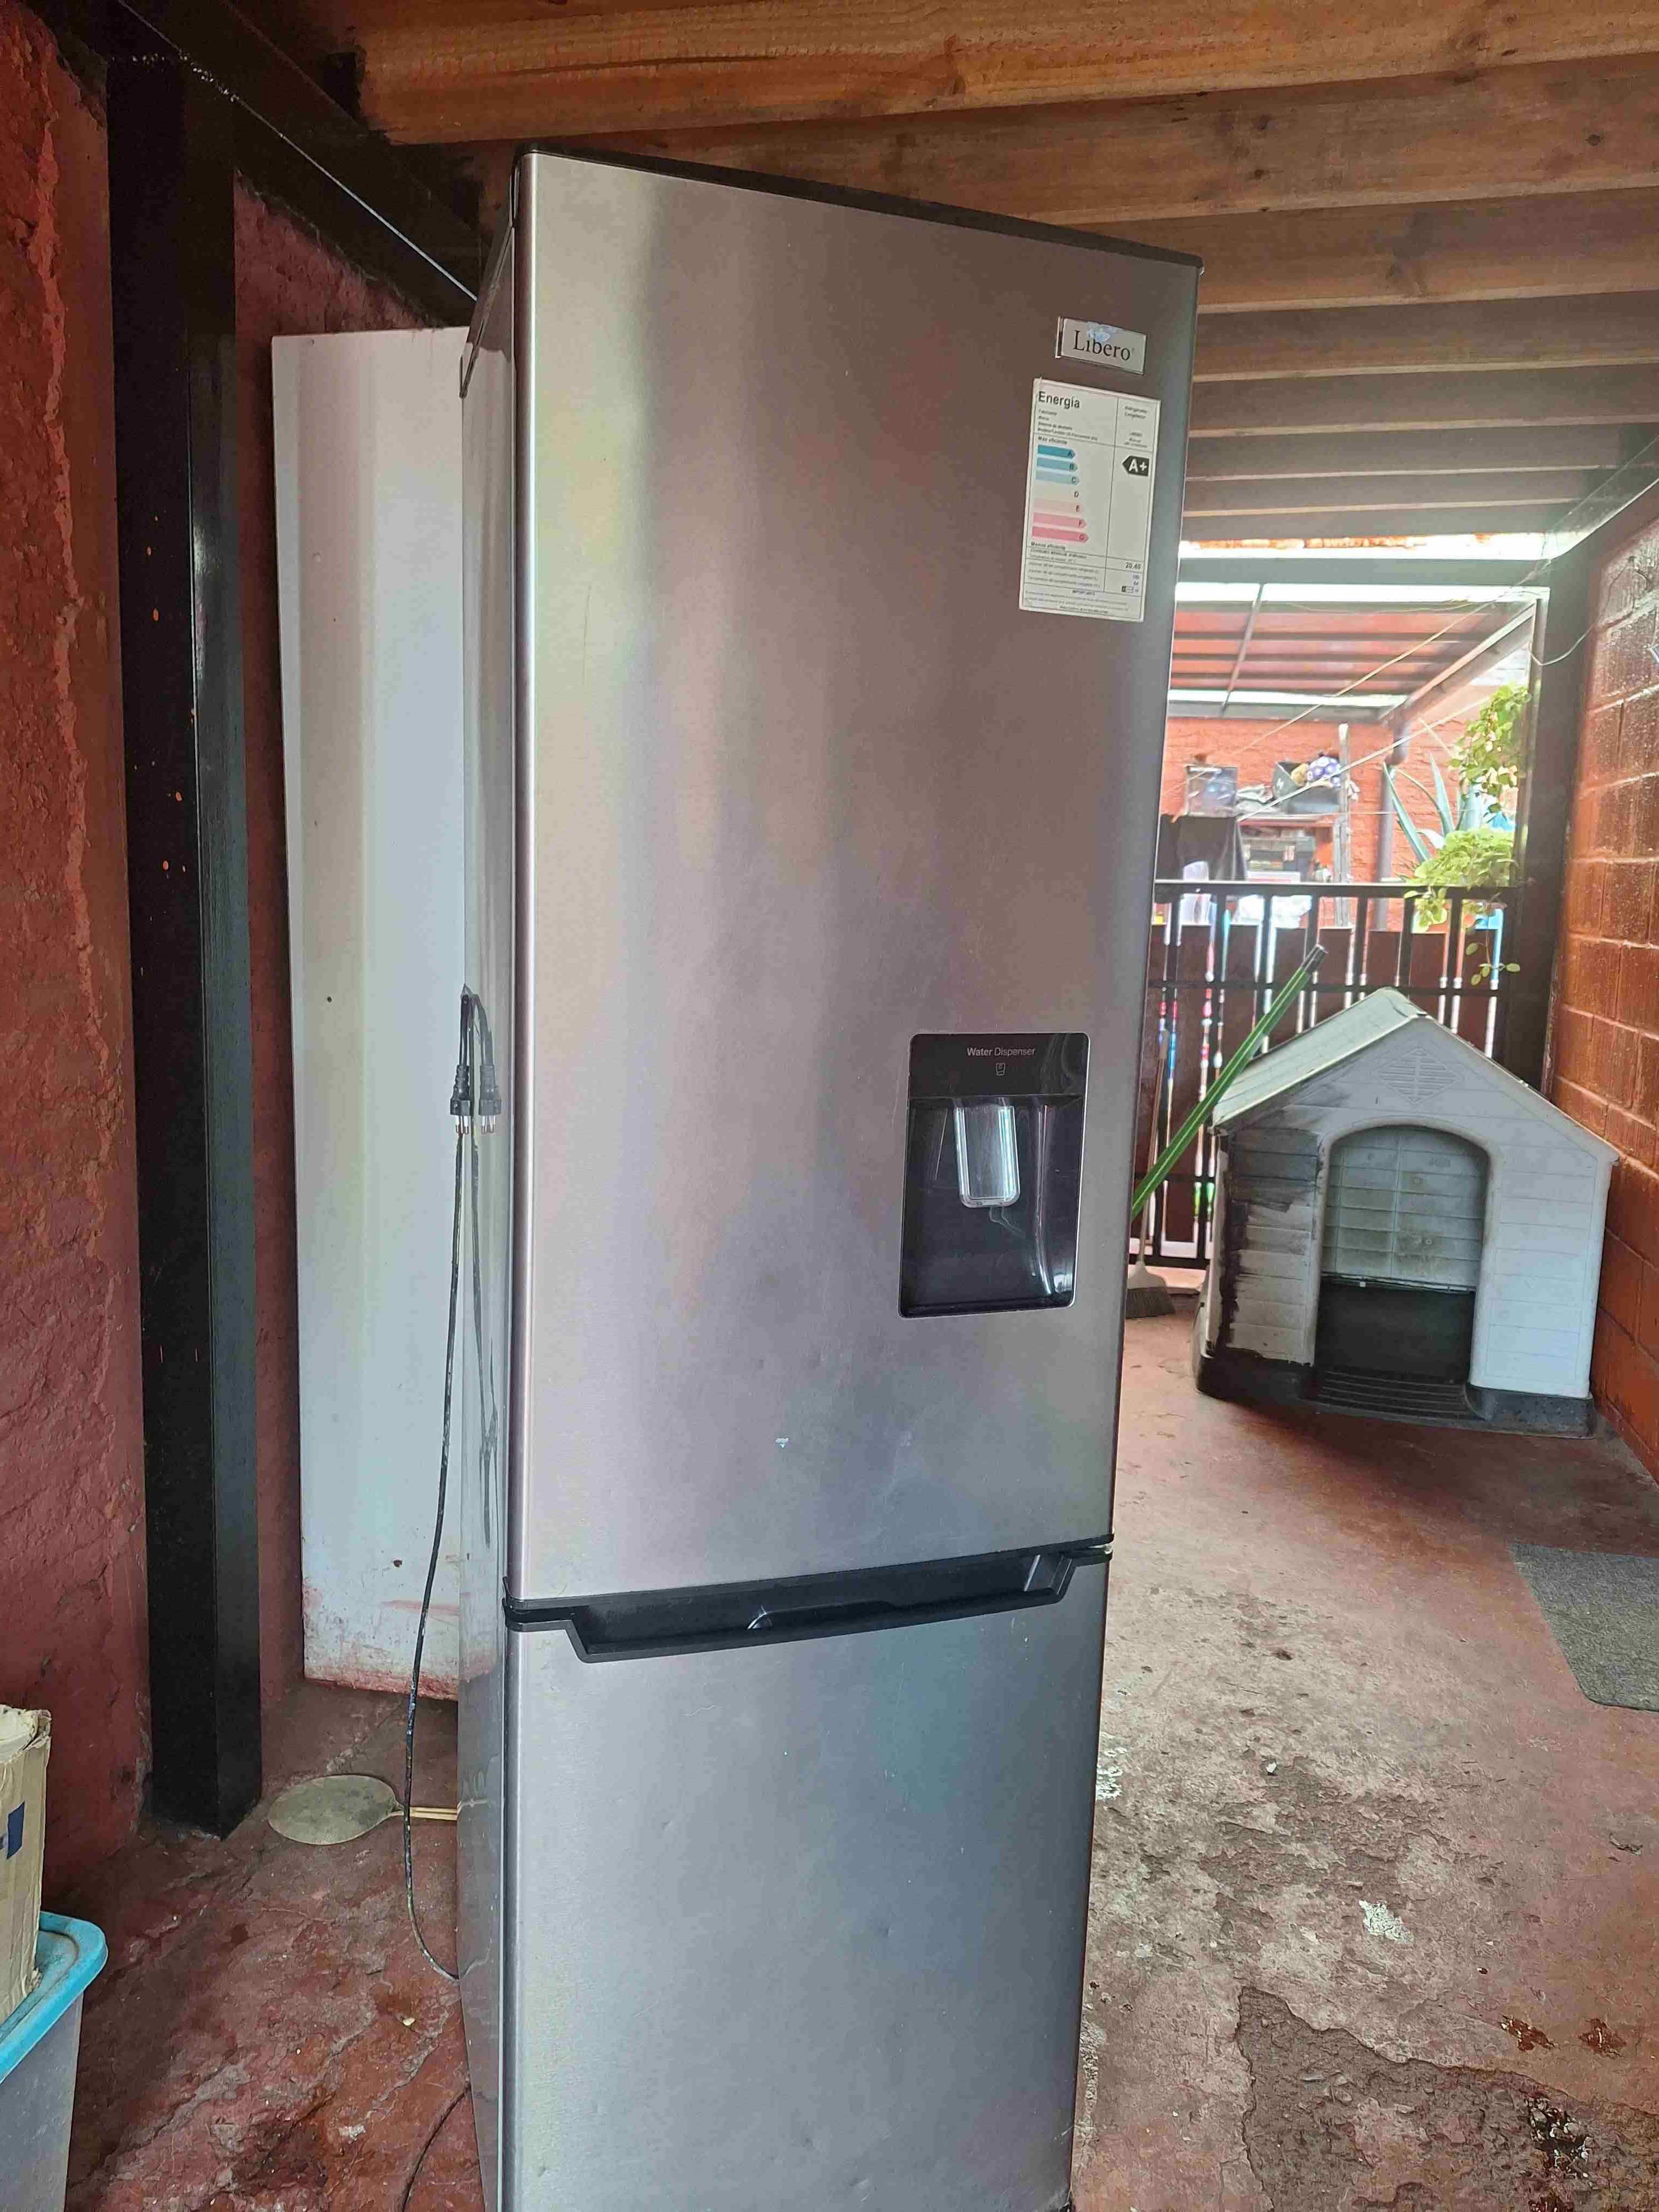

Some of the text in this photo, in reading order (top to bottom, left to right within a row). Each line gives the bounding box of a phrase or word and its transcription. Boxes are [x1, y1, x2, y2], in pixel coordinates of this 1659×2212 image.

[1073, 329, 1130, 361] Libero
[1038, 391, 1080, 409] Energía
[1129, 459, 1147, 473] A+
[967, 1047, 1035, 1056] Water Dispenser
